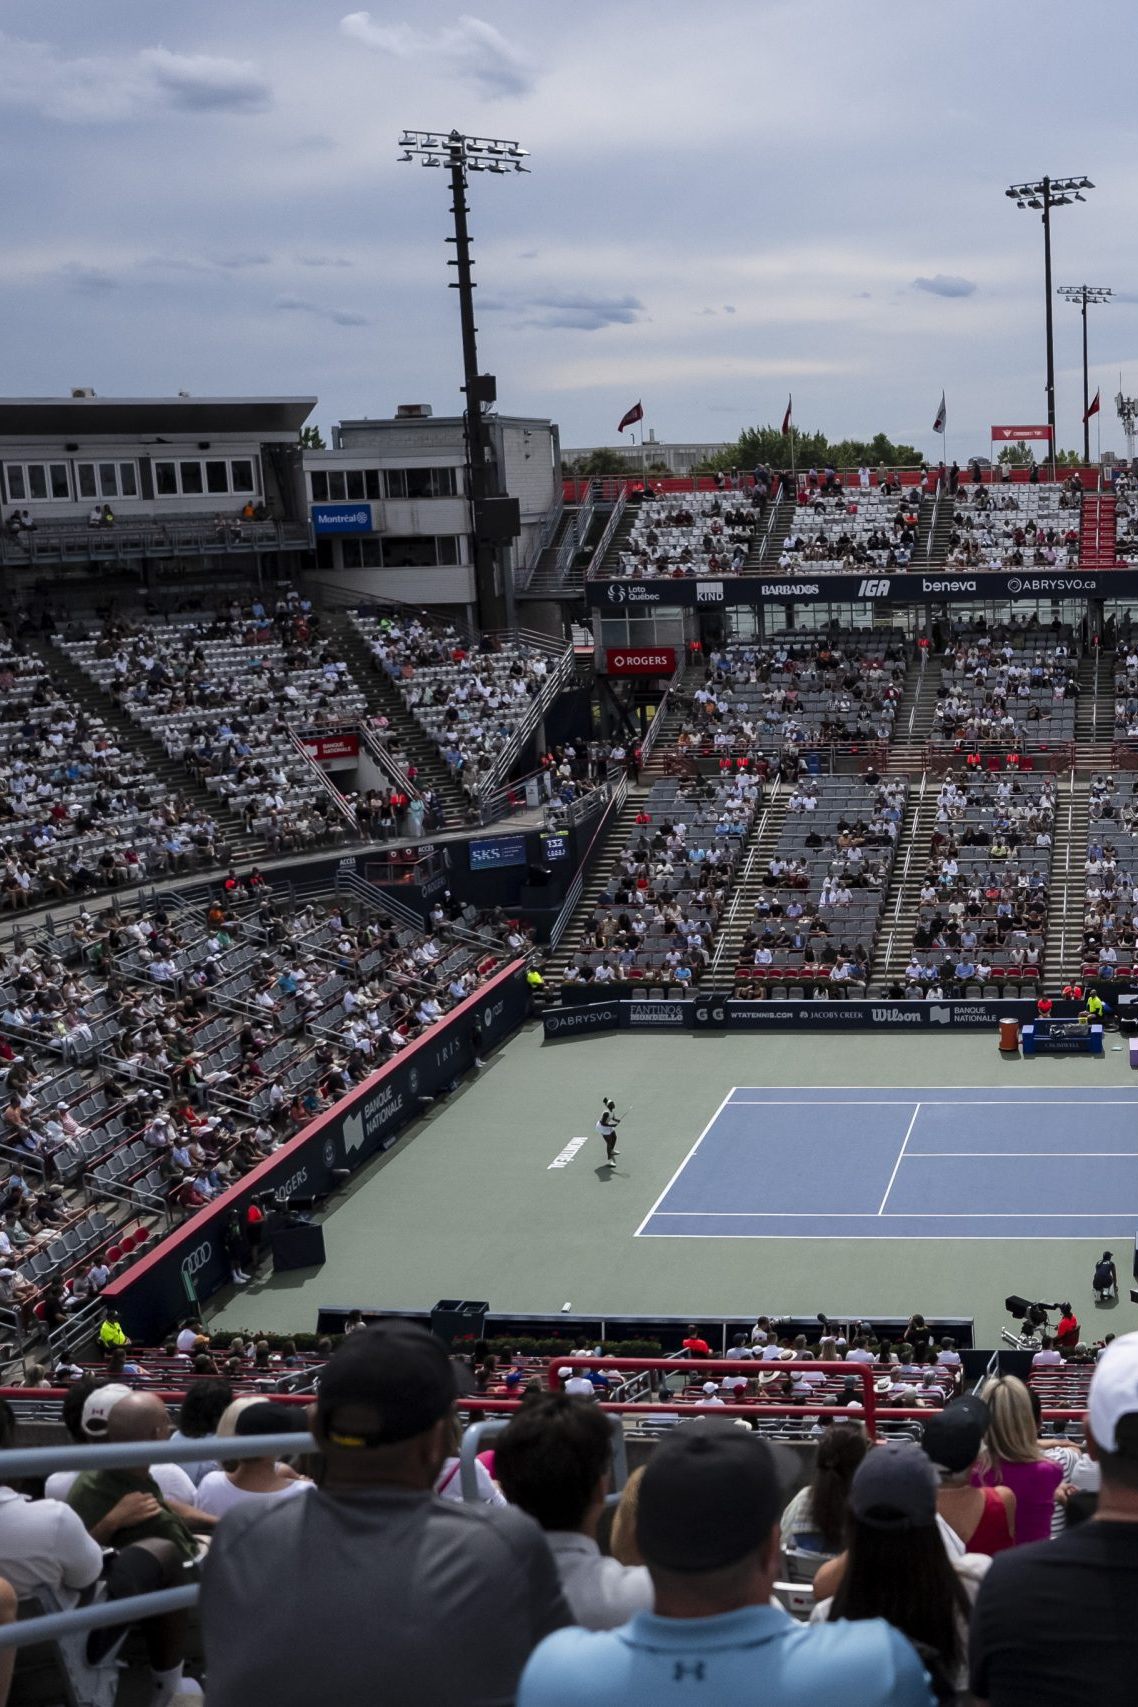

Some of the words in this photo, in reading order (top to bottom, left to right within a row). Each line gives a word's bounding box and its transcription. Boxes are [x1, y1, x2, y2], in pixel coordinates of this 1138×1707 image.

[318, 514, 356, 524] Montréal
[761, 584, 819, 595] BARBADOS
[858, 580, 891, 596] IGA
[922, 579, 976, 592] beneva
[1022, 579, 1096, 590] ABRYSVO.ca
[697, 592, 724, 601] KIND
[627, 656, 667, 665] ROGERS
[560, 1011, 611, 1026] ABRYSVO
[871, 1009, 921, 1022] Wilson
[954, 1014, 997, 1022] NATIONALE
[364, 1085, 393, 1119] BANQUE
[366, 1094, 403, 1136] NATIONALE
